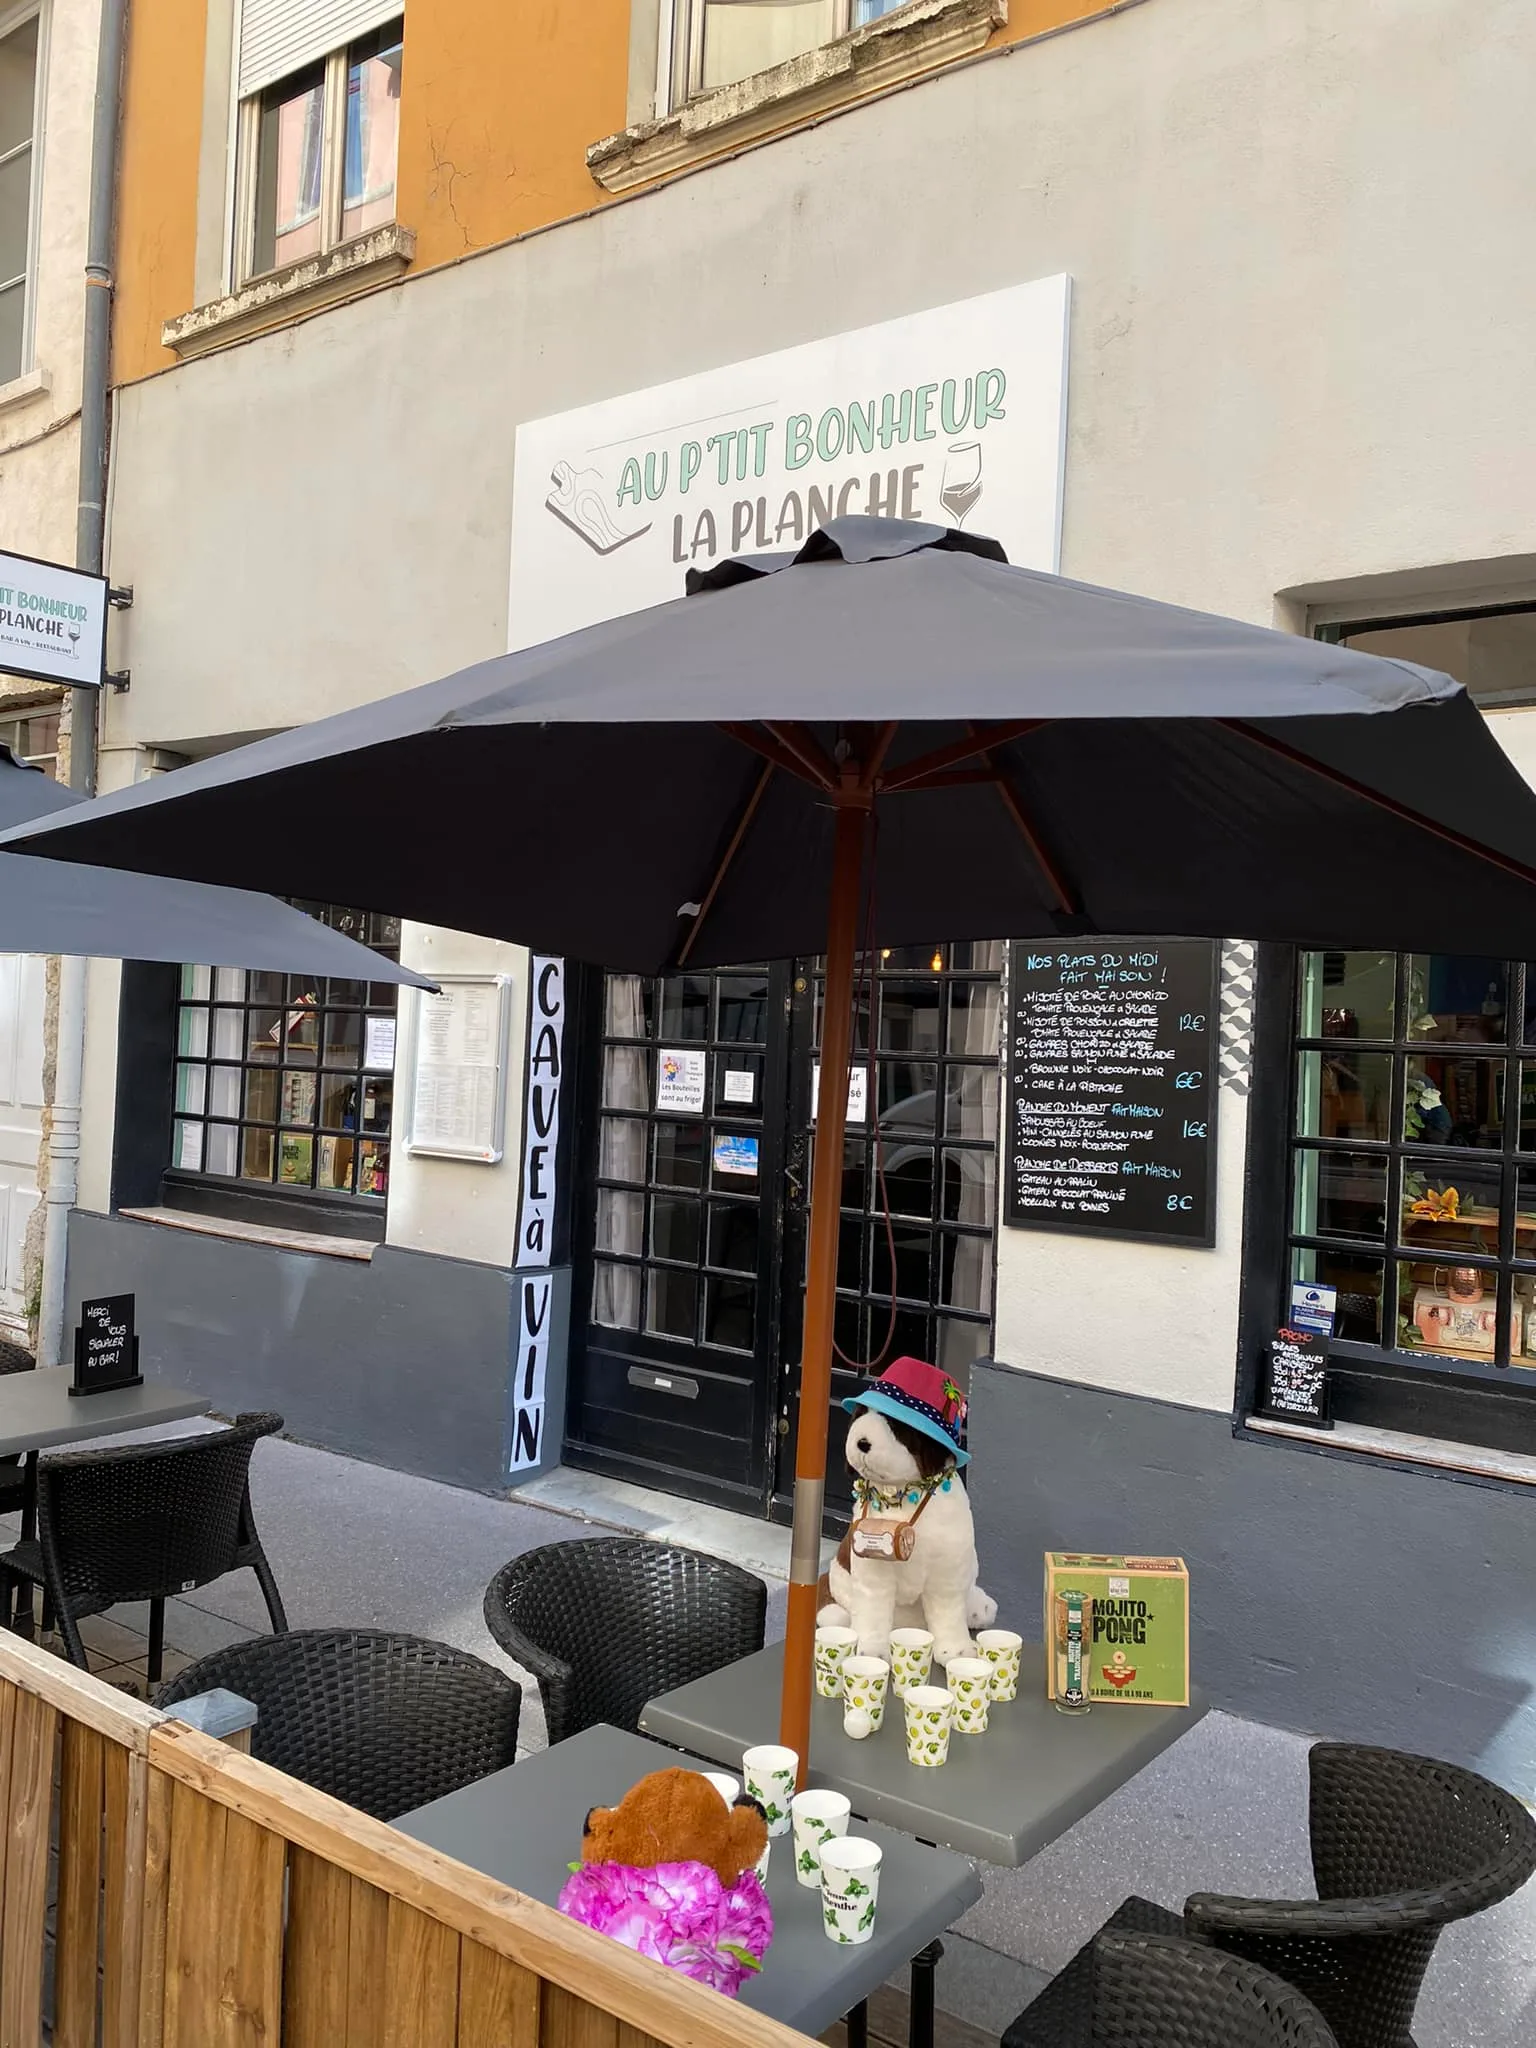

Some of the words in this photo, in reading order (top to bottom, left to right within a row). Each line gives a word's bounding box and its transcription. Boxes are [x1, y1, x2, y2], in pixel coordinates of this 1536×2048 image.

[617, 452, 669, 508] AU
[679, 422, 775, 493] P'TIT
[784, 368, 1007, 471] BONHEUR
[672, 507, 718, 564] LA
[731, 463, 925, 551] PLANCHE
[17, 591, 88, 622] BONHEUR
[0, 609, 64, 638] PLANCHE
[1027, 954, 1053, 970] NOS
[1057, 954, 1097, 968] PLATS
[1101, 953, 1123, 967] DU
[1060, 970, 1089, 984] FAIT
[1064, 991, 1079, 1001] DE
[1080, 990, 1107, 1002] PORC
[1108, 991, 1125, 1001] AU
[1125, 989, 1169, 1001] CHORIZO
[1124, 1003, 1158, 1015] SALADE
[1060, 1017, 1074, 1026] DE
[1074, 1016, 1112, 1027] POISSON
[1179, 1013, 1206, 1032] 12€
[1122, 1029, 1158, 1040] SALADE
[1136, 1049, 1176, 1060] SALADE
[1142, 1066, 1165, 1077] NOIR
[530, 961, 560, 1202] CAVE
[1031, 1080, 1055, 1090] CAKE
[1065, 1081, 1077, 1092] LA
[1176, 1071, 1203, 1089] 6€
[1054, 1102, 1069, 1112] DU
[1066, 1117, 1077, 1128] AU
[1083, 1129, 1095, 1138] AU
[1183, 1120, 1208, 1138] 16€
[1054, 1176, 1067, 1186] AU
[1061, 1200, 1075, 1210] AUX
[98, 1317, 111, 1327] DE
[108, 1325, 127, 1335] VOUS
[87, 1356, 97, 1367] AU
[514, 1282, 549, 1464] VIN
[1091, 1599, 1147, 1617] MOJITO
[1092, 1617, 1147, 1645] PONG
